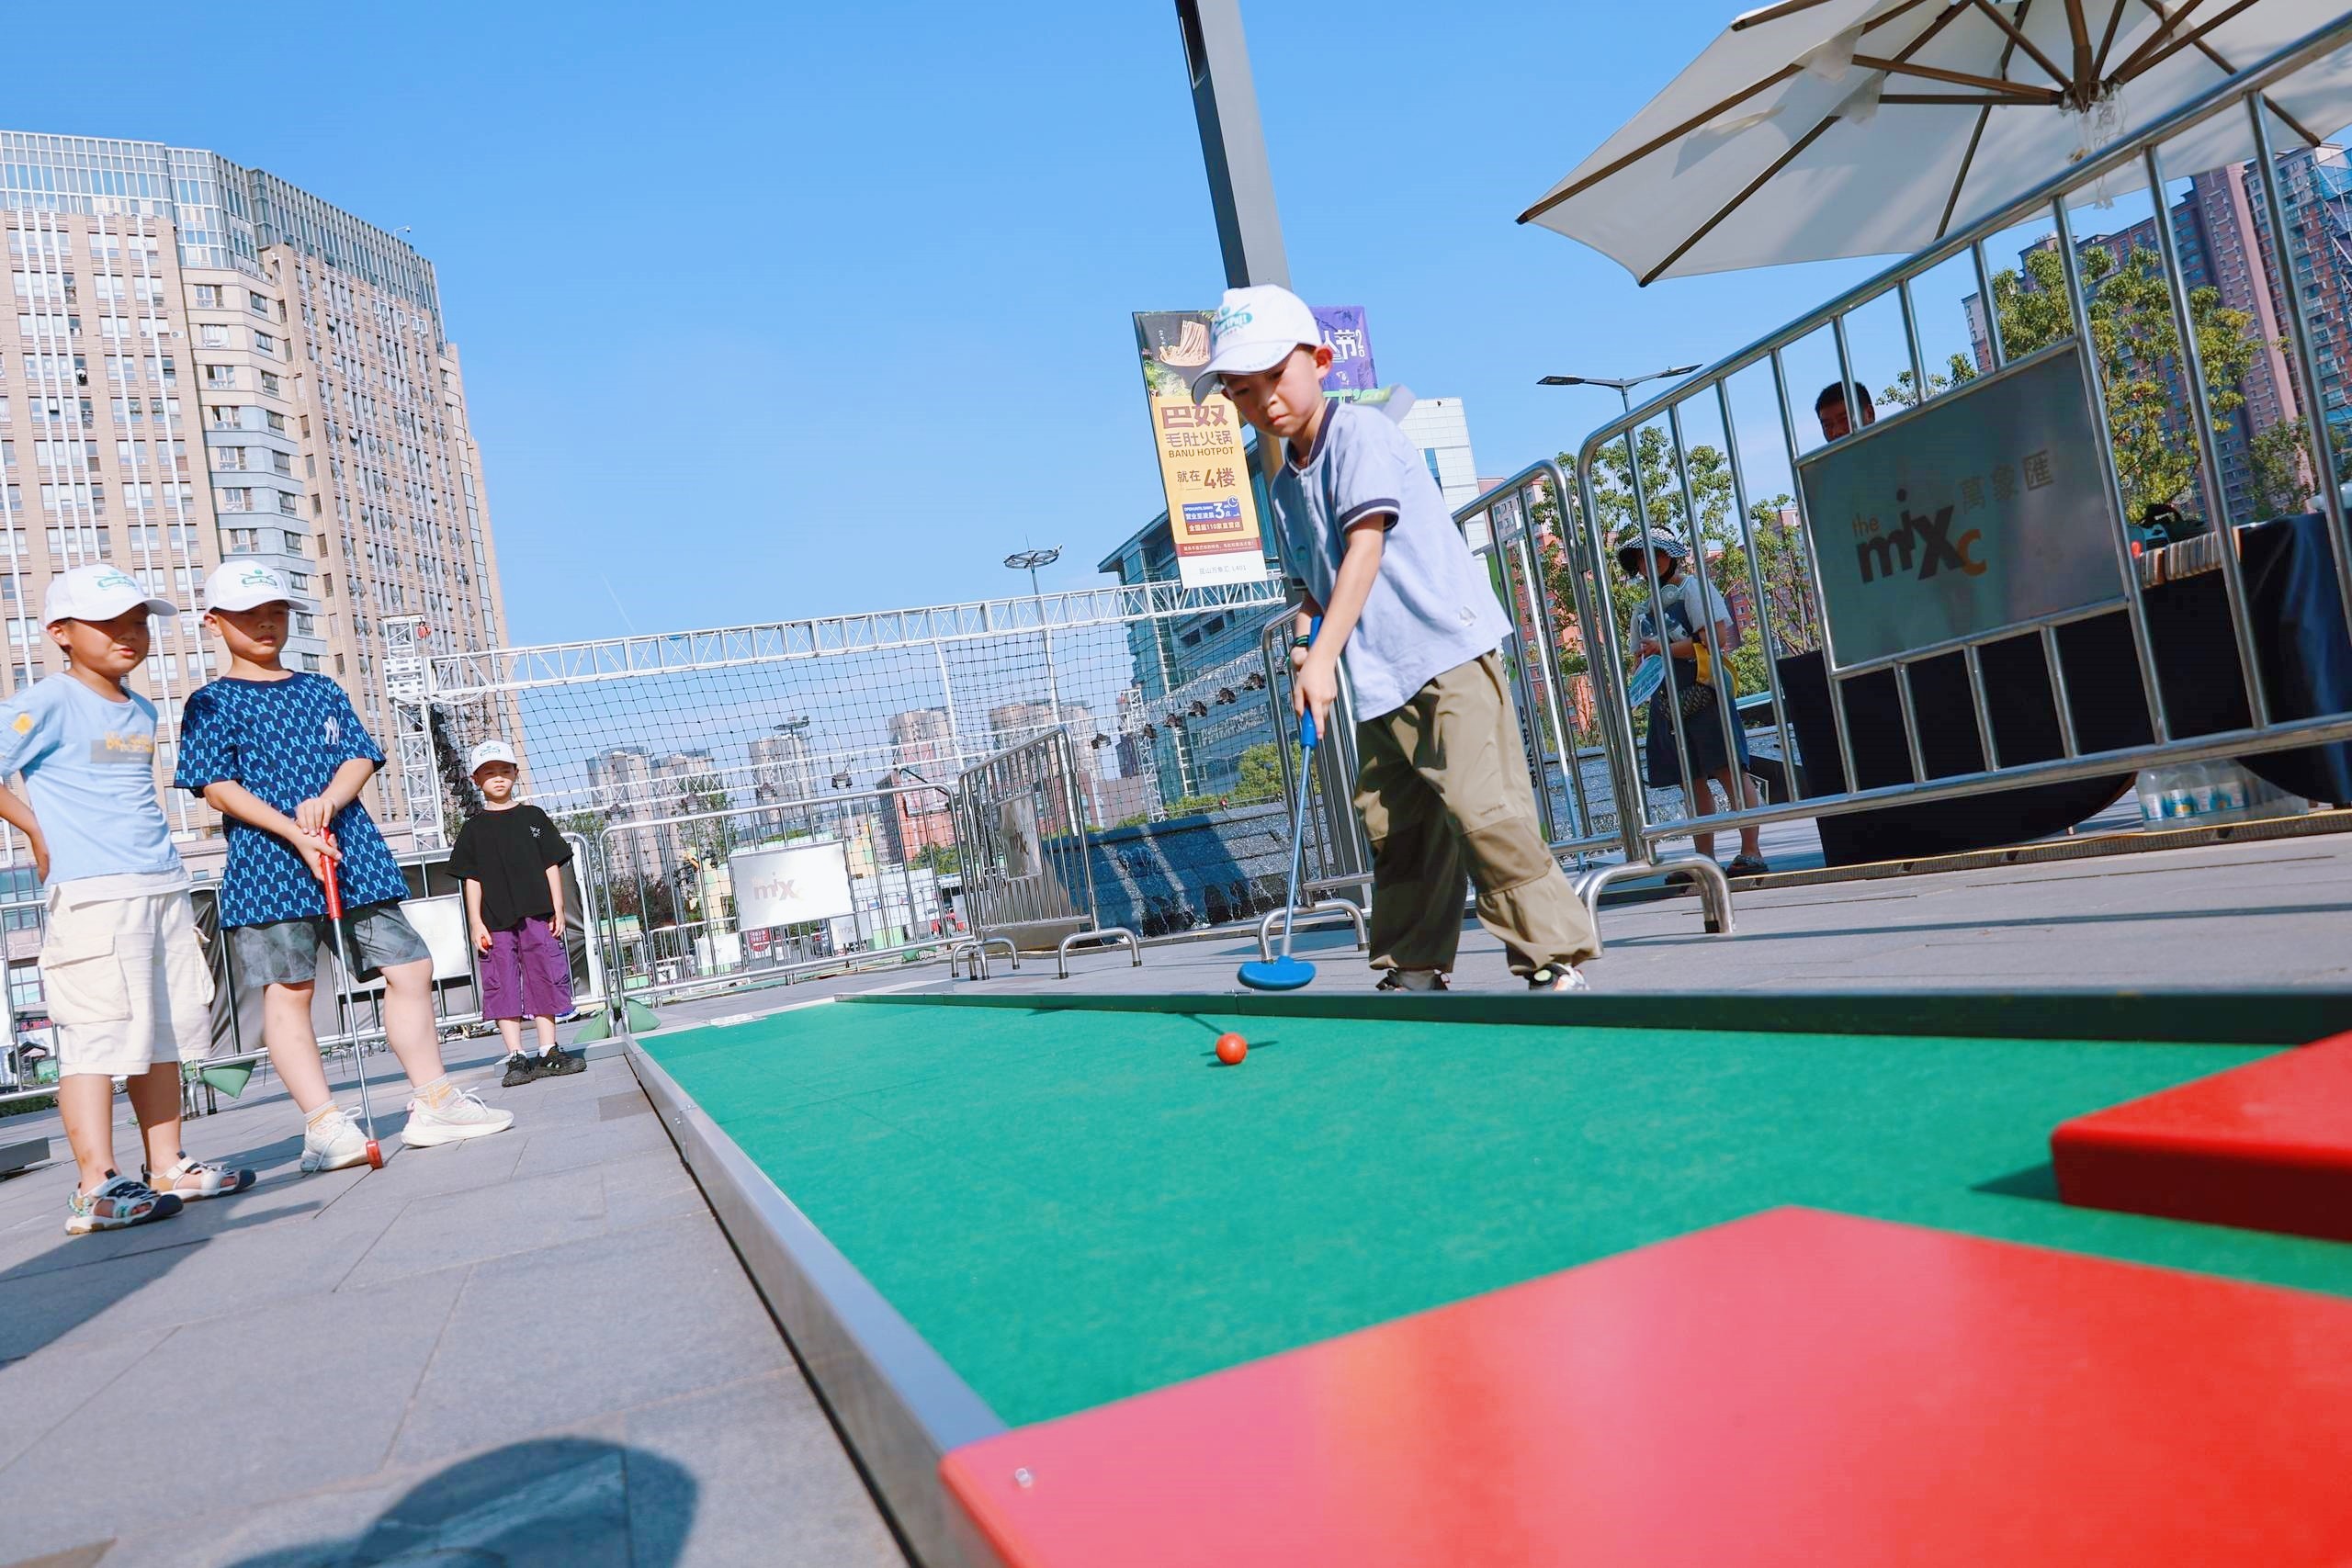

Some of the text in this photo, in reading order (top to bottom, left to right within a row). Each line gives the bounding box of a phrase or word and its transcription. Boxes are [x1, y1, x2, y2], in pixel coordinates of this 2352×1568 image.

[1160, 404, 1228, 429] 巴奴
[1165, 430, 1233, 447] 毛肚火锅
[1169, 446, 1234, 457] BANU HOTPOT
[1852, 512, 1880, 537] the
[323, 716, 340, 746] NY
